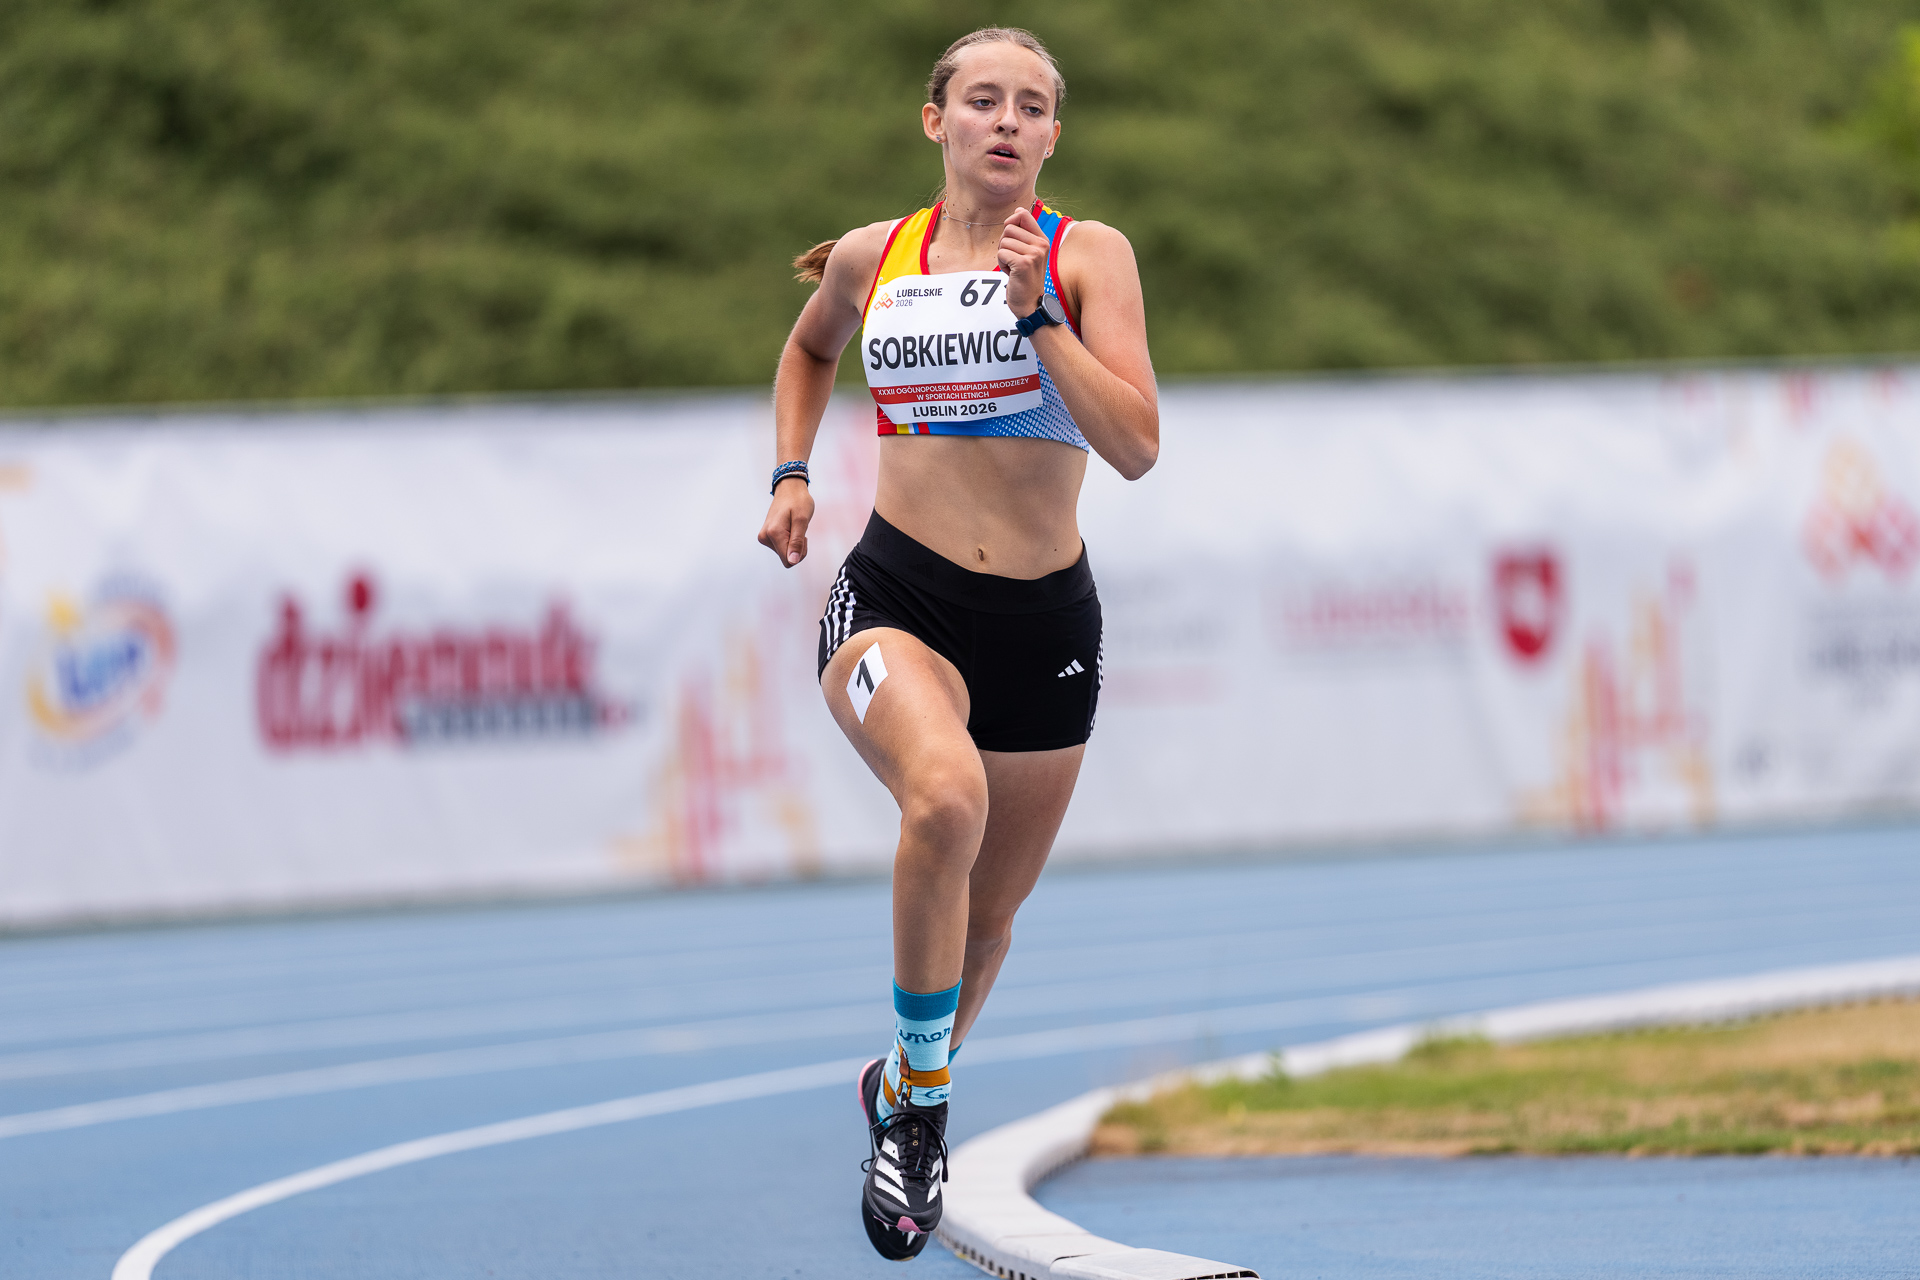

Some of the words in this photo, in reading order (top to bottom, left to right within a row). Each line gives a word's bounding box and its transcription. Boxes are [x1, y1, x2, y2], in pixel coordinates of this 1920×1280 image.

[896, 287, 943, 298] LUBELSKIE
[960, 279, 1008, 307] 67
[895, 299, 913, 307] 2026
[868, 329, 1027, 371] SOBKIEWICZ
[877, 388, 896, 396] XXXII
[896, 384, 951, 395] OGÓLNOPOLSKA
[951, 383, 989, 392] OLIMPIADA
[989, 377, 1030, 389] MŁODZIEŻY
[925, 392, 960, 401] SPORTACH
[960, 391, 990, 400] LETNICH
[912, 405, 958, 418] LUBLIN
[960, 402, 997, 416] 2026
[856, 658, 875, 695] 1
